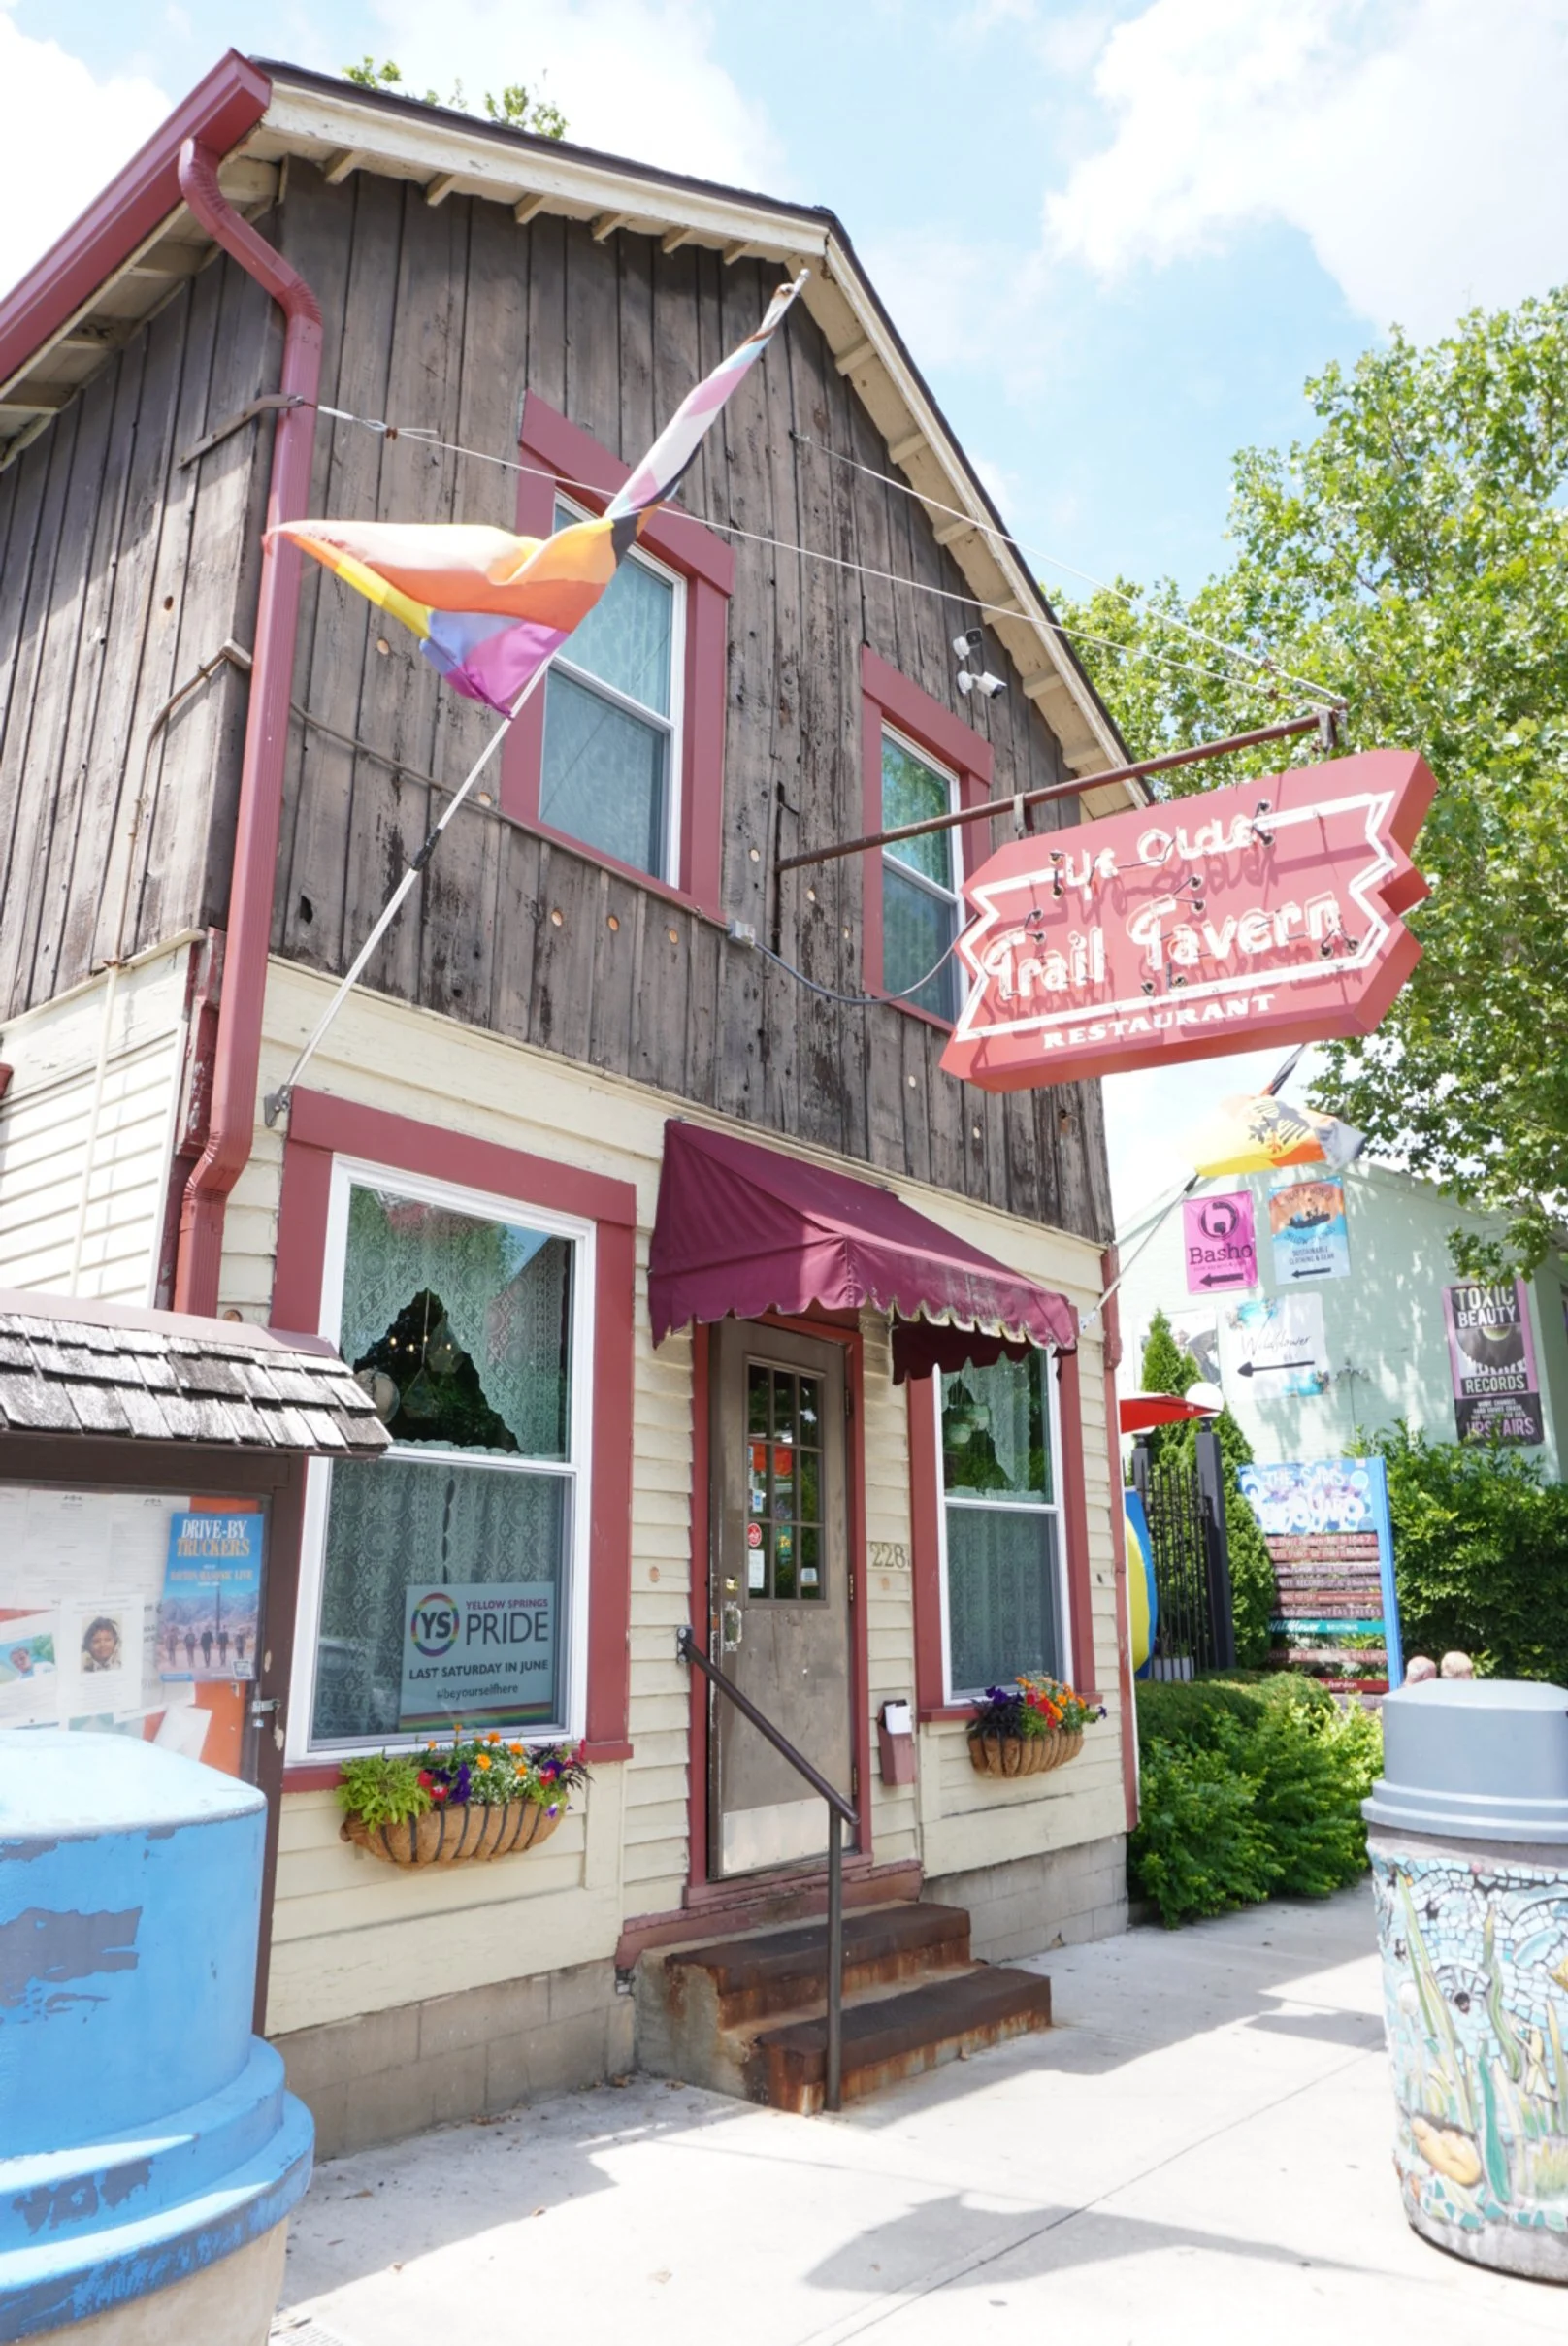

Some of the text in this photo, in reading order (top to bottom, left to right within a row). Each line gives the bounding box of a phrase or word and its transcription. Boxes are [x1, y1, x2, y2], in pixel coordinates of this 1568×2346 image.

[1137, 814, 1256, 866] Olde
[982, 891, 1341, 1000] Trail Tavern
[1043, 994, 1275, 1049] RESTAURANT
[1189, 1242, 1253, 1265] Basho
[1456, 1285, 1514, 1310] TOXIC
[1457, 1305, 1516, 1327] BEAUTY
[1465, 1374, 1525, 1393] RECORDS
[1466, 1417, 1535, 1438] UPSAIRS
[181, 1519, 247, 1539] DRIVE-BY
[177, 1537, 250, 1557] TRUCKERS
[869, 1541, 906, 1569] 228
[466, 1598, 548, 1611] YELLOW SPRINGS
[420, 1611, 452, 1640] YS
[466, 1611, 548, 1645] PRIDE
[408, 1659, 549, 1679] LAST SATURDAY IN JUNE
[437, 1683, 519, 1700] #beyourselfhere
